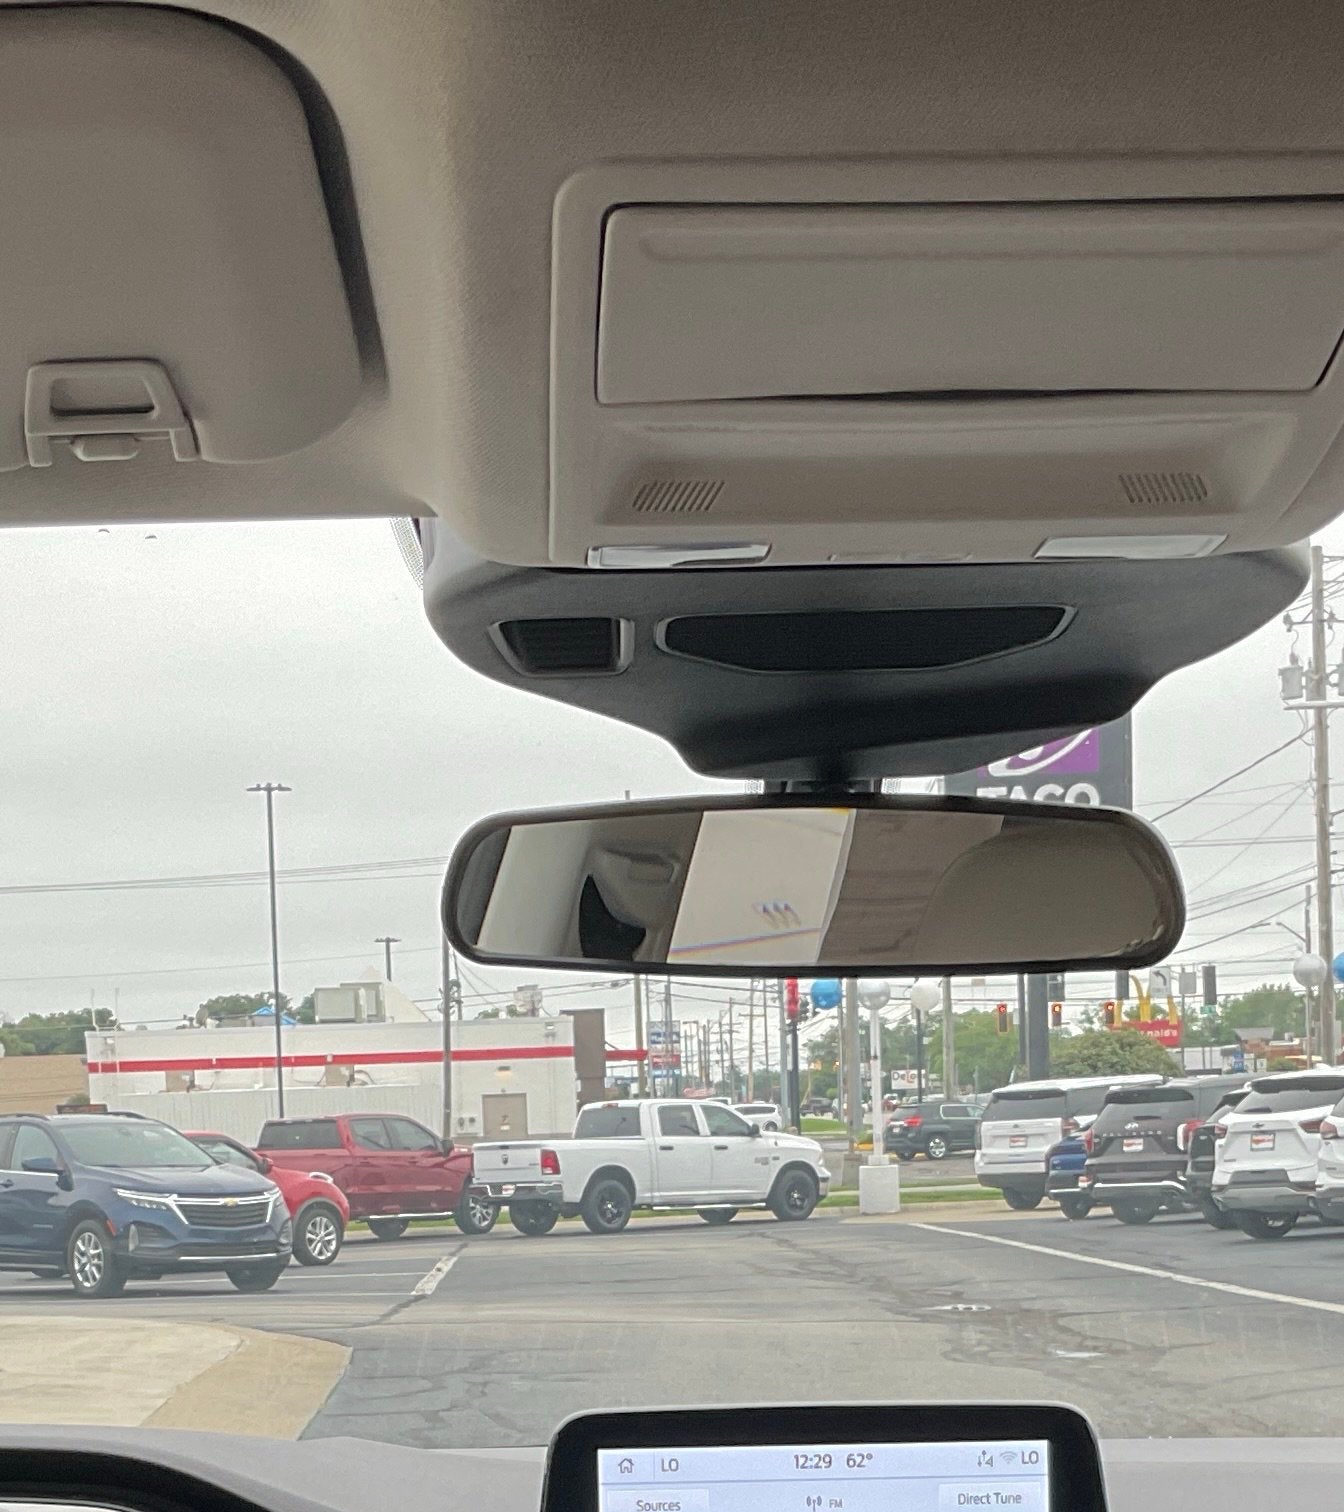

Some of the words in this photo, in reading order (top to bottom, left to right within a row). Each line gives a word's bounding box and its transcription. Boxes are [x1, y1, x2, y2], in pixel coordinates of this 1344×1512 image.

[661, 1458, 680, 1473] LO
[794, 1453, 833, 1470] 12:29
[846, 1452, 874, 1470] 62°
[1021, 1450, 1040, 1467] LO
[636, 1499, 681, 1512] Sources
[829, 1499, 844, 1509] FM
[957, 1491, 990, 1506] Direct
[993, 1490, 1023, 1506] Tune
